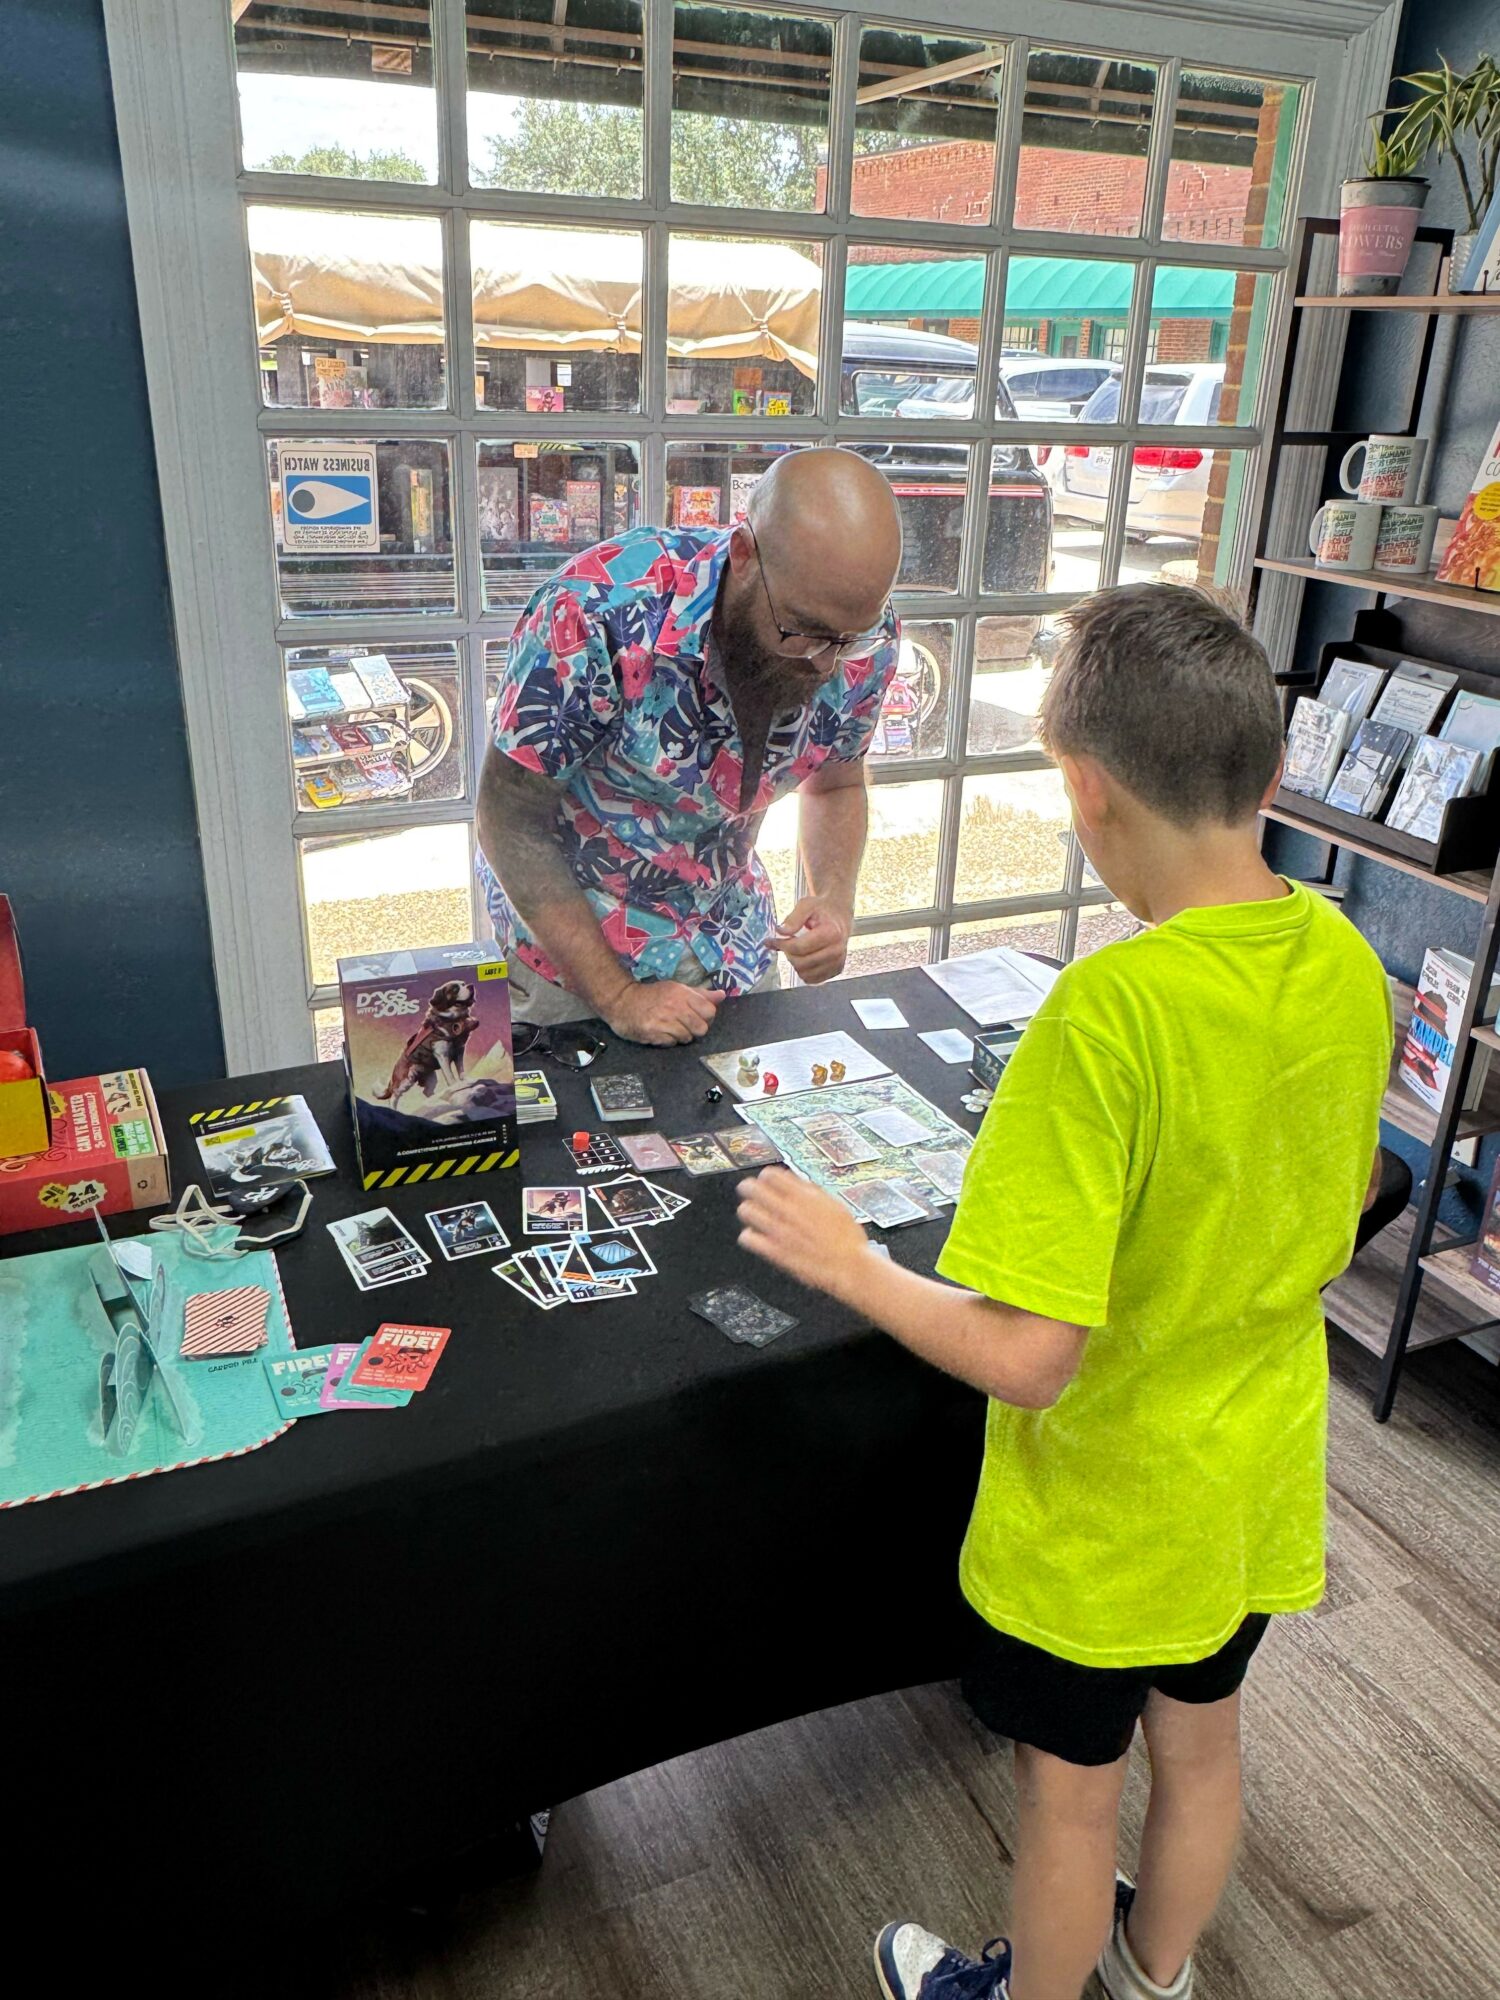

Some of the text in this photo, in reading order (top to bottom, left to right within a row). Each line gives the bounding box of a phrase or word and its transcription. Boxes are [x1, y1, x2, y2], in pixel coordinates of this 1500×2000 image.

[356, 988, 407, 1008] DOGS
[374, 999, 420, 1018] JOBS
[70, 1094, 89, 1125] MASTER
[76, 1136, 92, 1152] CAN
[68, 1183, 97, 1204] 2-4
[72, 1194, 100, 1209] PLAYERS
[378, 1333, 440, 1350] FIRE!
